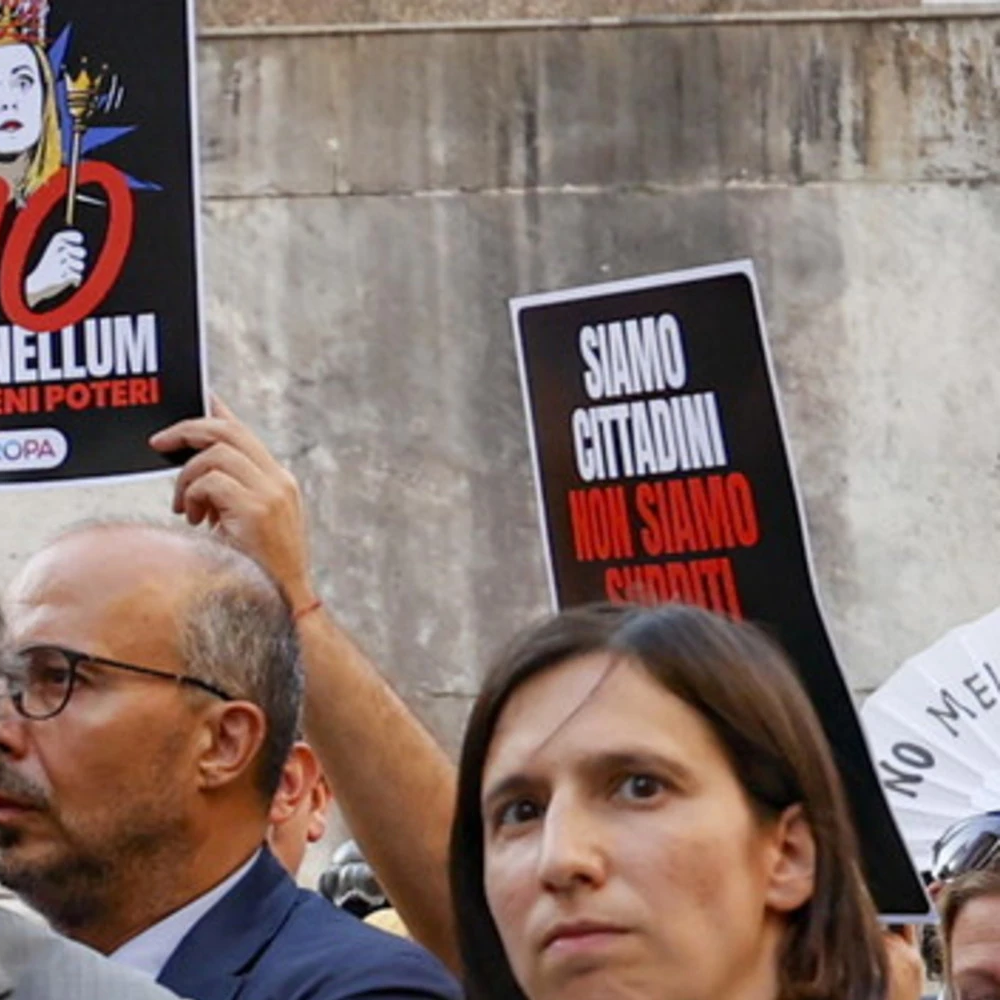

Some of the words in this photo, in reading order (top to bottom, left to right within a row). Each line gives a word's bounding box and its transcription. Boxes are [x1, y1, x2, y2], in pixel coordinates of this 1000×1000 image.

[45, 377, 160, 412] POTERI
[578, 313, 686, 399] SIAMO
[572, 392, 726, 482] CITTADINI
[569, 486, 634, 561] NON
[636, 473, 759, 555] SIAMO
[879, 741, 936, 799] NO
